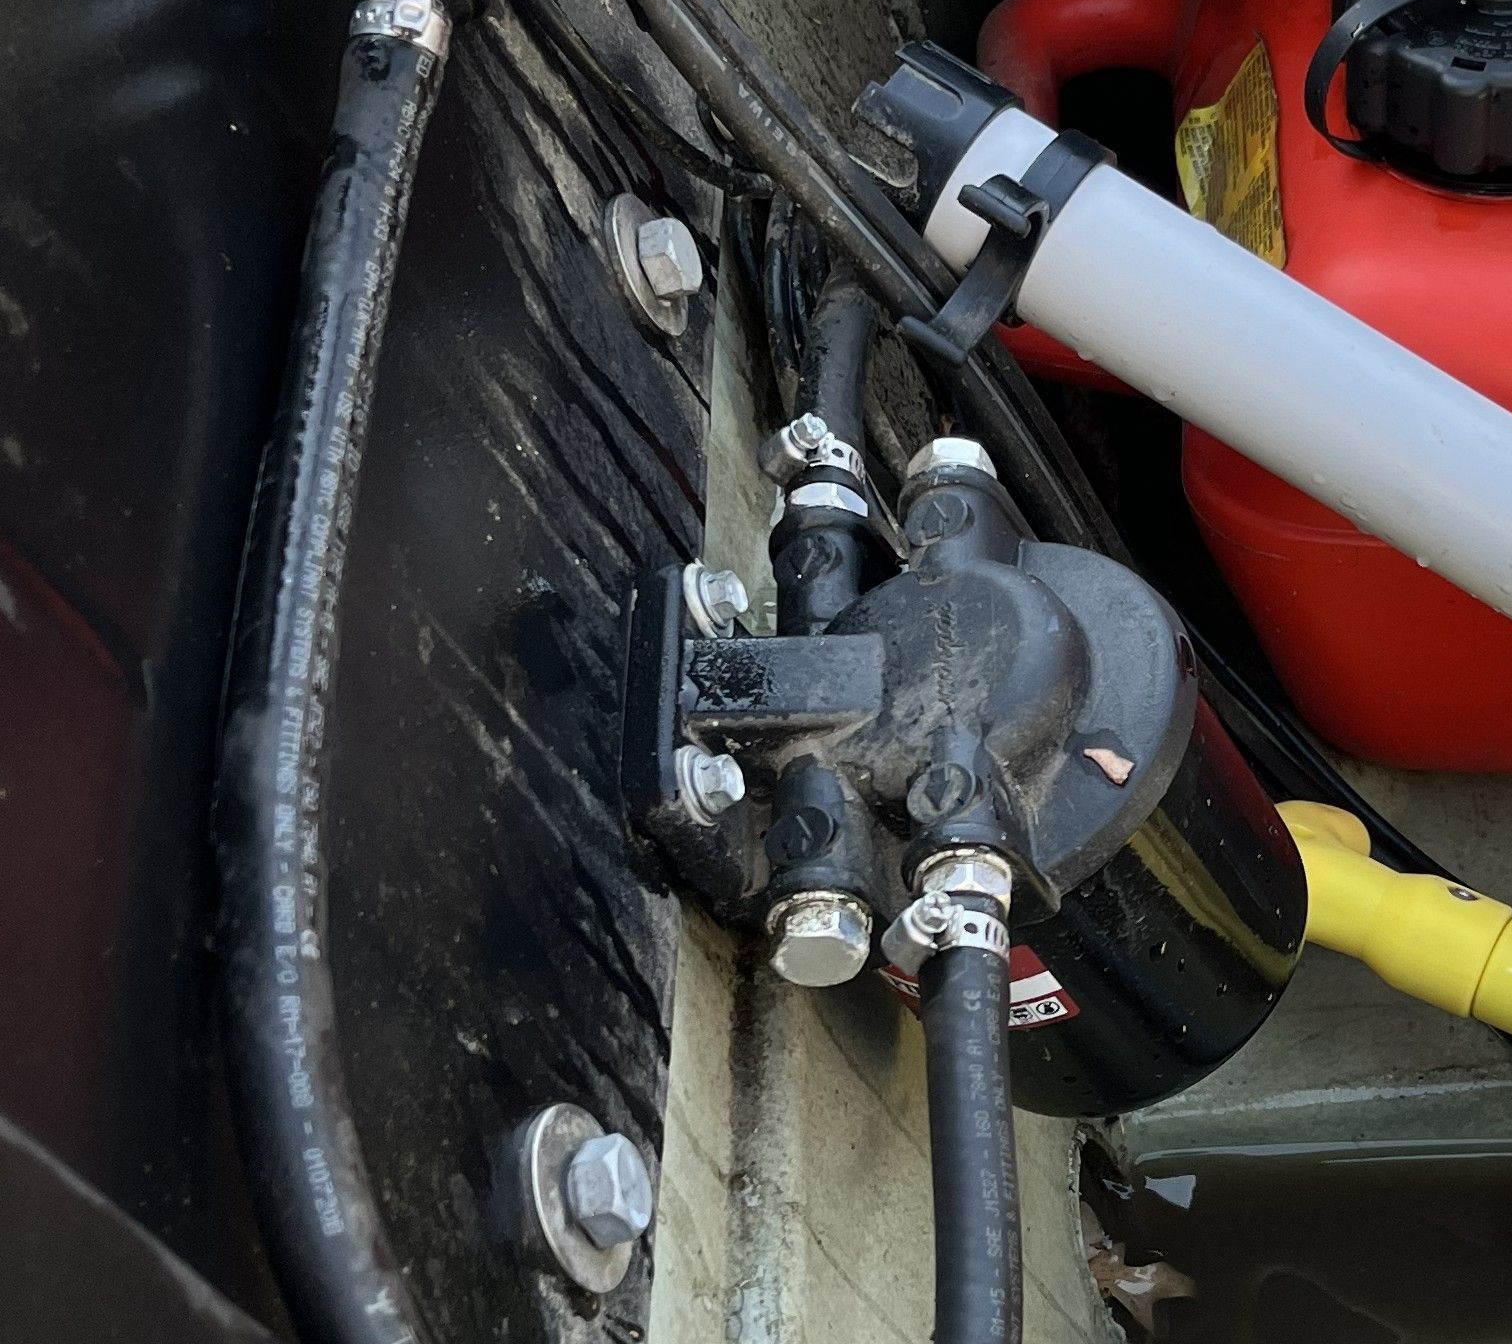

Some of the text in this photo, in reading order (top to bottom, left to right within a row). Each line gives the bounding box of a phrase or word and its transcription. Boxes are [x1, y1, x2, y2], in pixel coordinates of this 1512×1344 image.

[288, 606, 317, 679] SYSTEMS
[275, 705, 304, 795] FITTINGS
[273, 802, 296, 851] ONLY
[962, 989, 981, 1011] CE
[985, 1225, 1003, 1258] SAE
